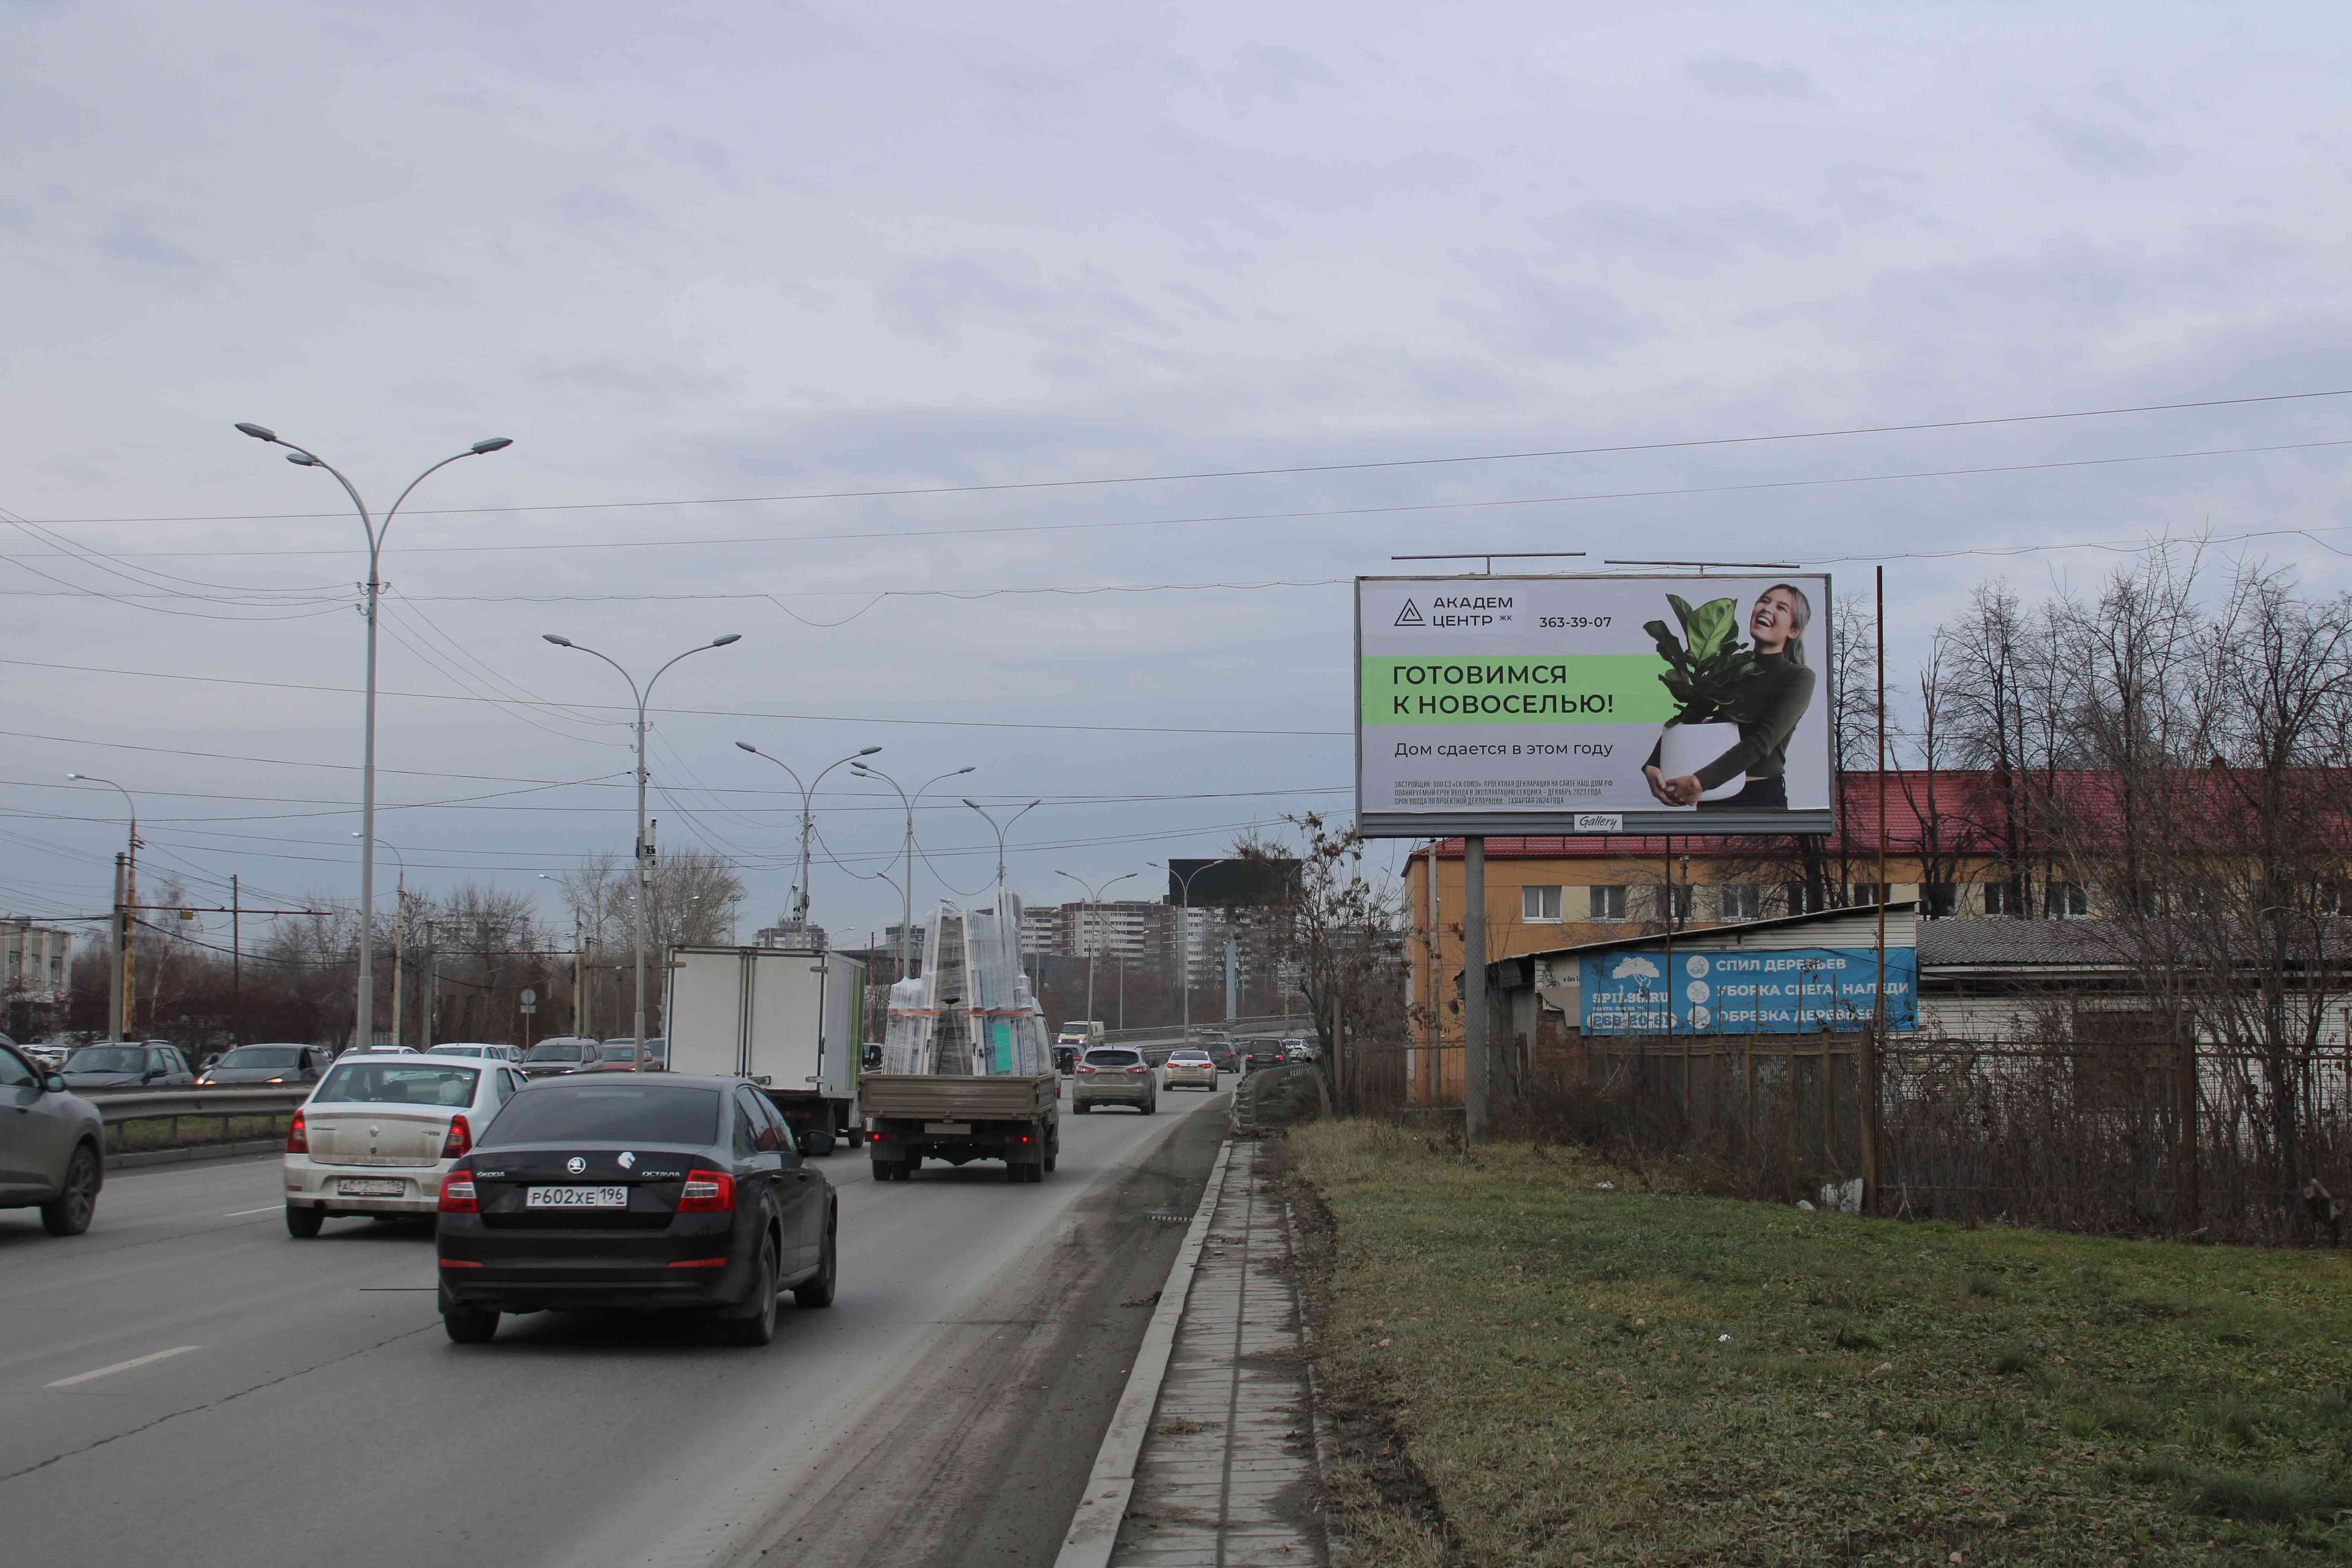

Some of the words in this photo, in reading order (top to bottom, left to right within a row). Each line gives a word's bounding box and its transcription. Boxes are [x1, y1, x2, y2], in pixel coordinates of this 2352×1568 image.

[1433, 597, 1513, 609] АКАДЕМ
[1433, 615, 1493, 628] ЦЕНТР
[1539, 617, 1611, 628] 363-39-07
[1393, 665, 1566, 685] ГОТОВИМСЯ
[1393, 695, 1410, 714] К
[1419, 694, 1613, 714] НОВОСЕЛЬЮ!
[1395, 742, 1431, 758] Дом
[1438, 745, 1506, 757] сдается
[1512, 745, 1521, 755] в
[1526, 744, 1567, 755] этом
[1574, 744, 1613, 757] году
[1580, 815, 1618, 831] Gallery
[1716, 960, 1760, 971] СПИЛ
[1717, 984, 1781, 997] УБОРКА
[1842, 982, 1909, 995] НАЛДИ
[1717, 1009, 1790, 1022] ОБРЕЗКА
[600, 1188, 623, 1200] 196
